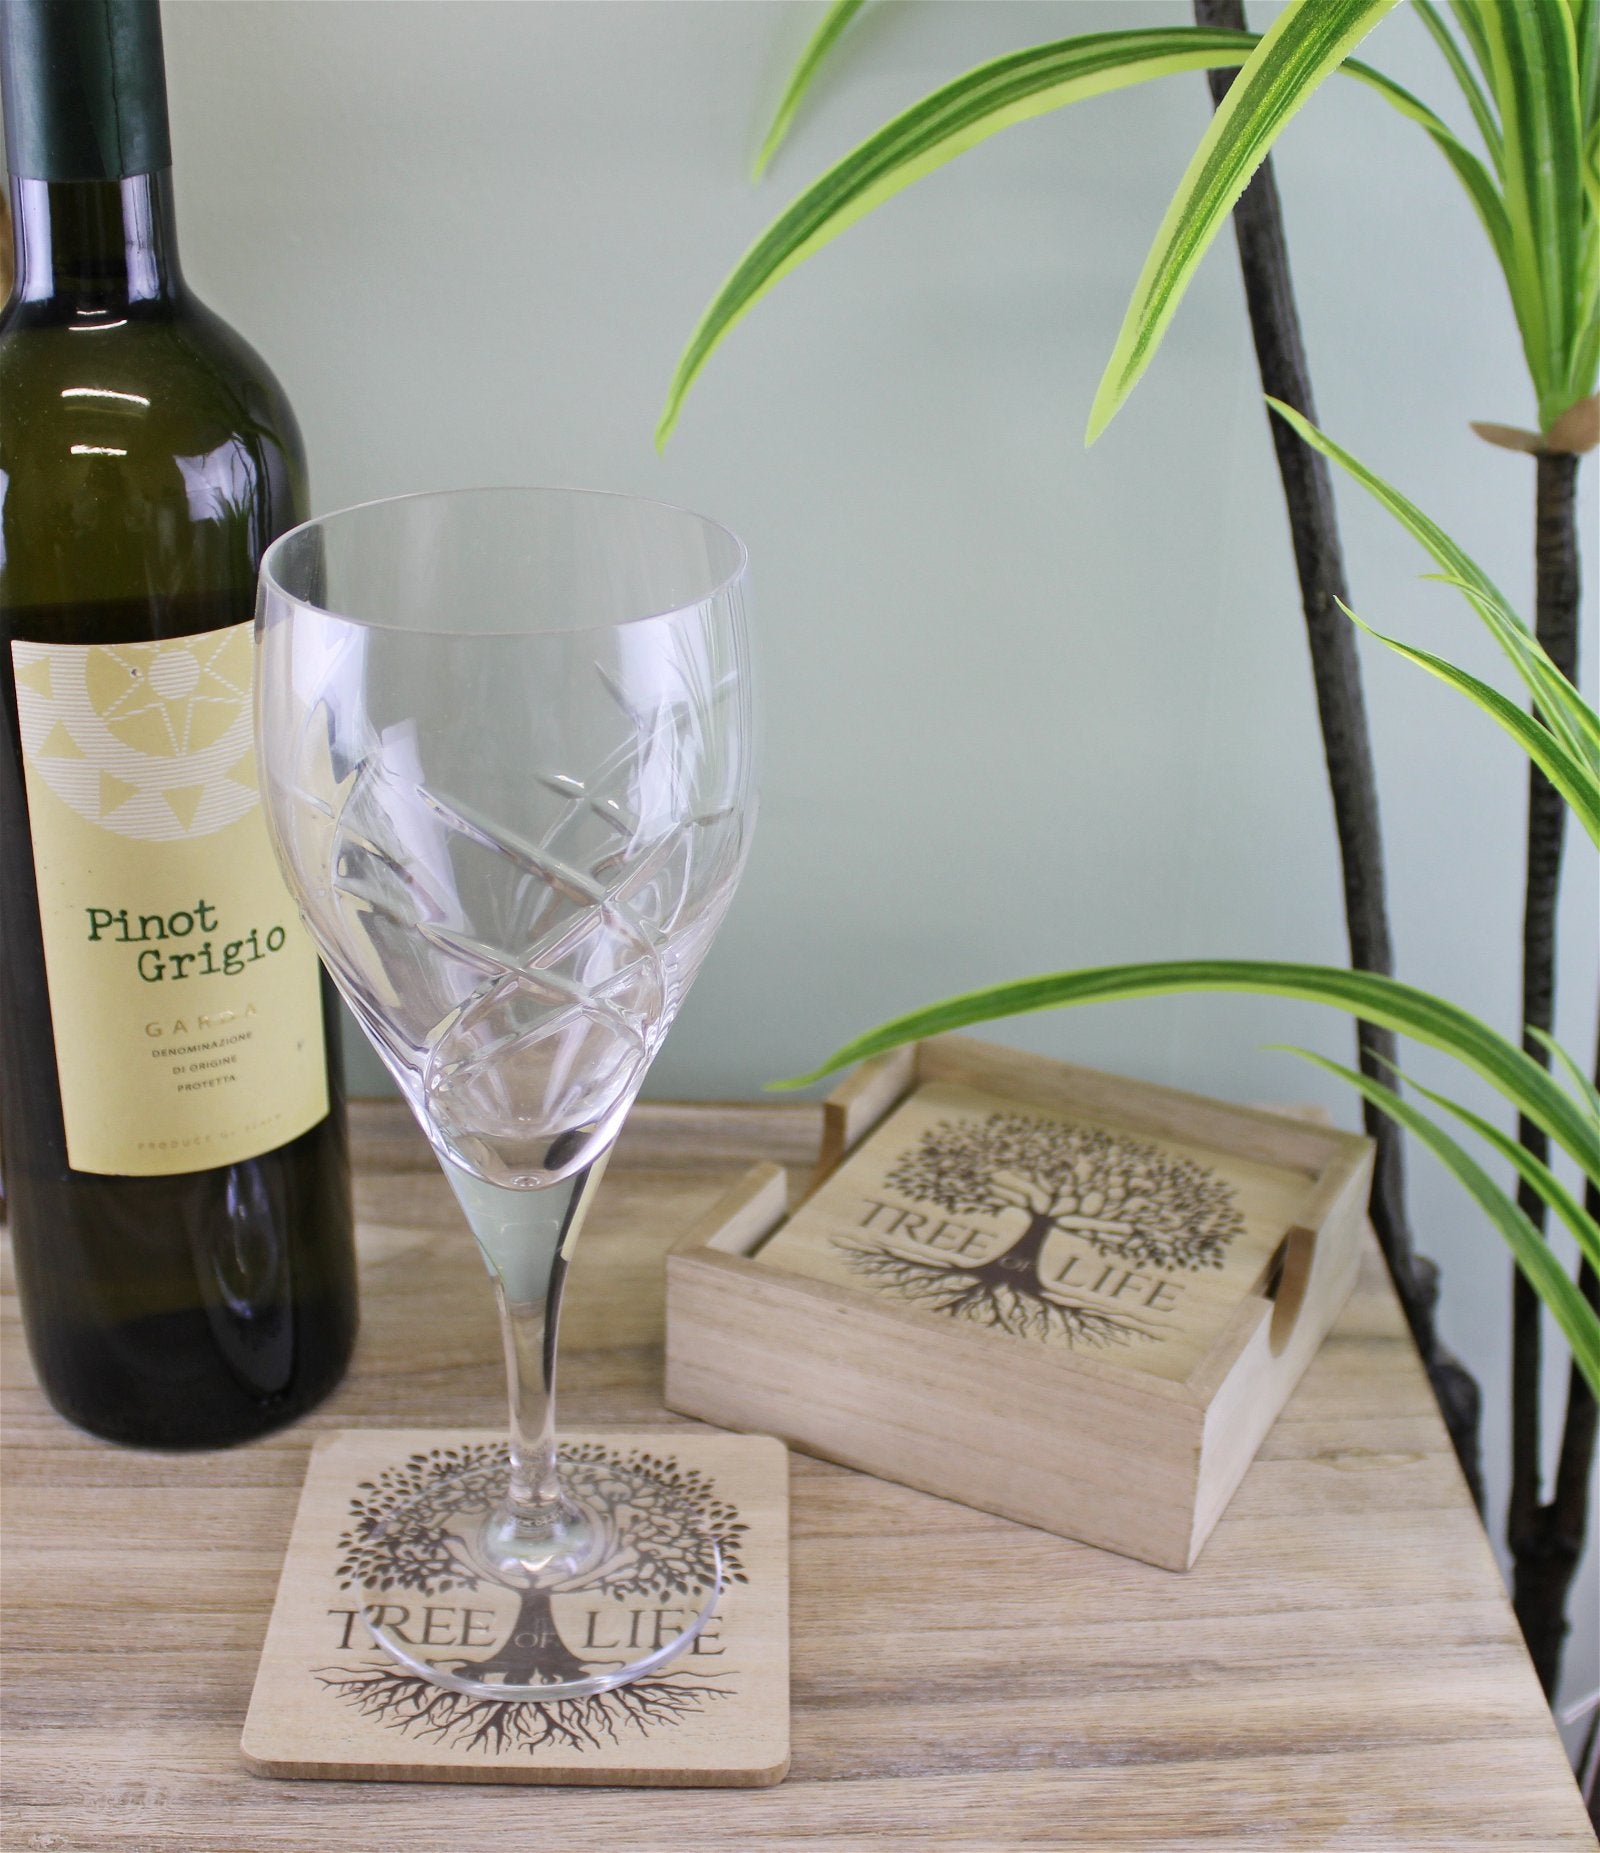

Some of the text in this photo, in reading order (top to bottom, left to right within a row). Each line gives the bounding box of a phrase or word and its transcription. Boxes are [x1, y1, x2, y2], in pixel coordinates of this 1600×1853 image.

[85, 899, 219, 942] Pinot
[137, 925, 286, 983] Grigio
[151, 1031, 253, 1058] DENOMINAZIONE
[172, 1054, 238, 1076] DI ORIGINE
[177, 1074, 236, 1093] PROTETTA
[860, 1199, 999, 1257] TREE
[1055, 1256, 1186, 1312] LIFE
[328, 1605, 727, 1656] TREE OF LIFE
